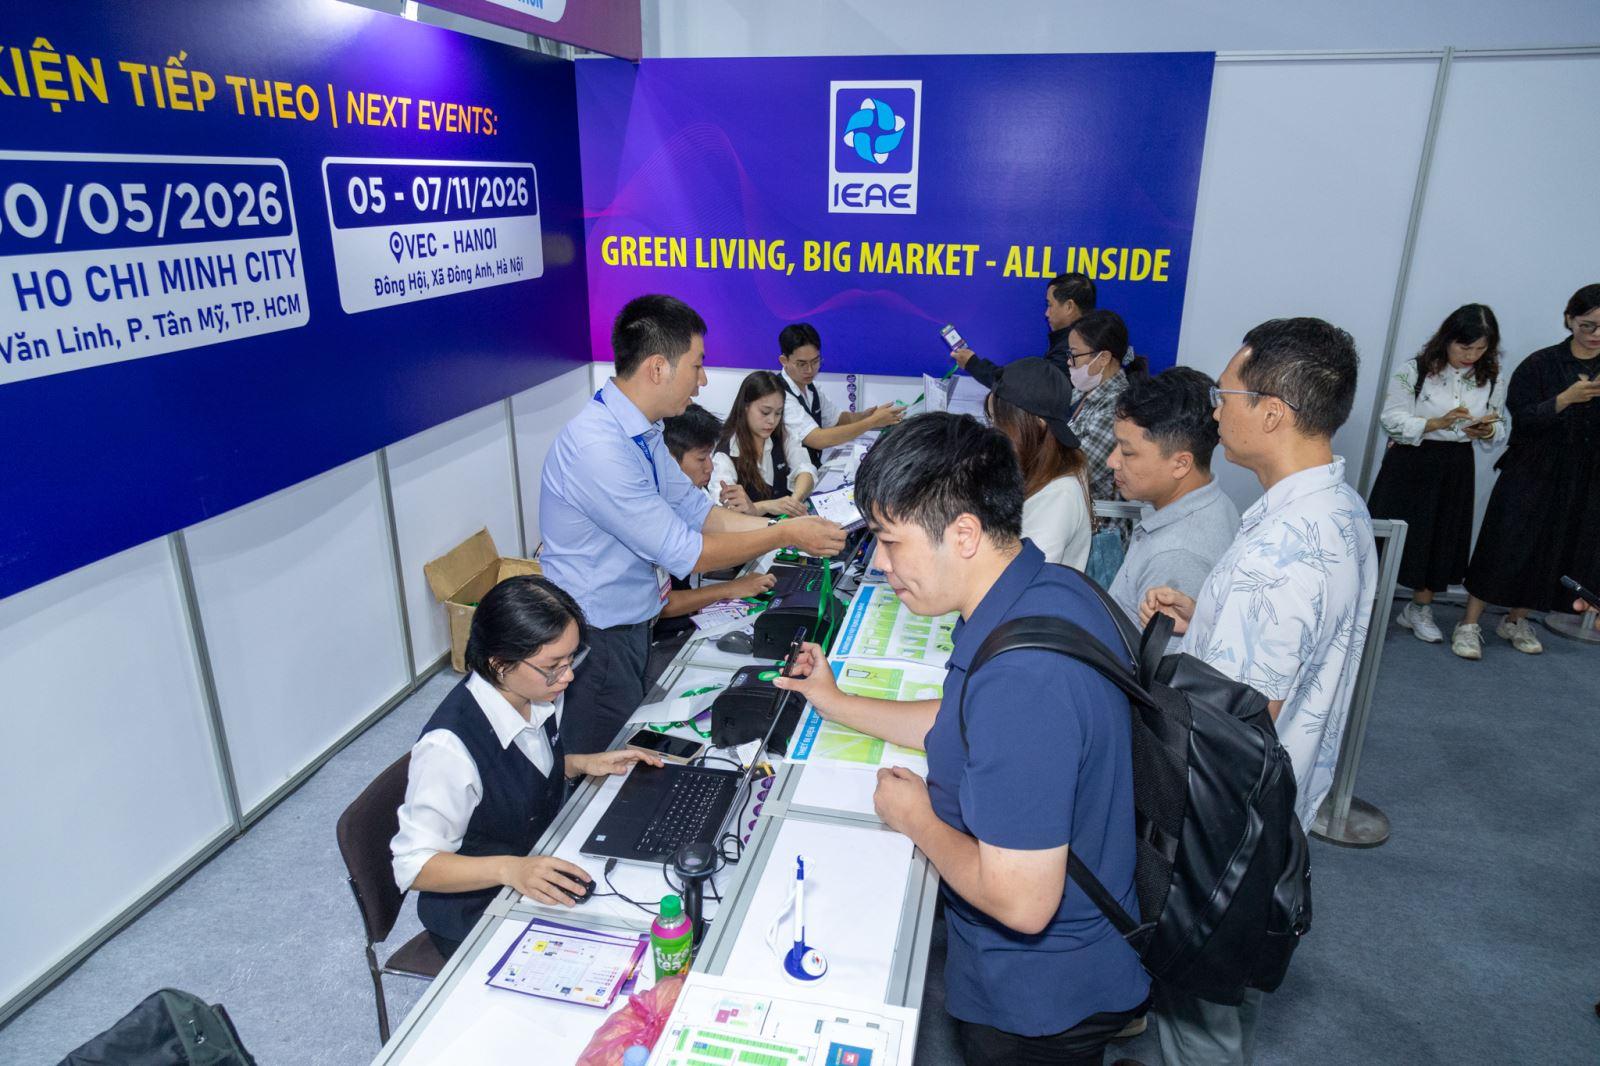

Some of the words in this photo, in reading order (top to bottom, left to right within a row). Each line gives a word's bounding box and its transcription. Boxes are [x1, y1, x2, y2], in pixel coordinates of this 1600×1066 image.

[118, 50, 216, 112] TIẾP
[225, 75, 320, 122] THEO
[347, 91, 411, 128] NEXT
[418, 99, 498, 136] EVENTS:
[0, 181, 283, 244] 0/05/2026
[347, 176, 386, 215] 05
[394, 191, 404, 201] -
[412, 176, 529, 215] 07/11/2026
[834, 183, 912, 208] IEAE
[404, 232, 438, 260] VEC
[453, 227, 498, 254] HANOI
[601, 236, 687, 267] GREEN
[695, 238, 796, 276] LIVING,
[803, 240, 851, 273] BIG
[858, 242, 980, 276] MARKET
[1003, 245, 1057, 279] ALL
[1066, 247, 1171, 282] INSIDE
[12, 268, 73, 312] HO
[85, 261, 150, 303] CHI
[158, 253, 238, 294] MINH
[245, 248, 297, 284] CITY
[374, 275, 406, 297] Đông
[408, 271, 430, 294] Hội,
[432, 267, 445, 286] Xã
[447, 265, 473, 284] Đông
[475, 263, 495, 279] Anh,
[496, 256, 508, 275] Hà
[510, 256, 524, 276] Nội
[56, 322, 121, 355] Linh,
[127, 317, 150, 343] P.
[152, 309, 193, 338] Tân
[197, 303, 230, 334] Mỹ,
[231, 300, 261, 325] TP.
[264, 293, 302, 320] HCM
[656, 957, 682, 971] tea
